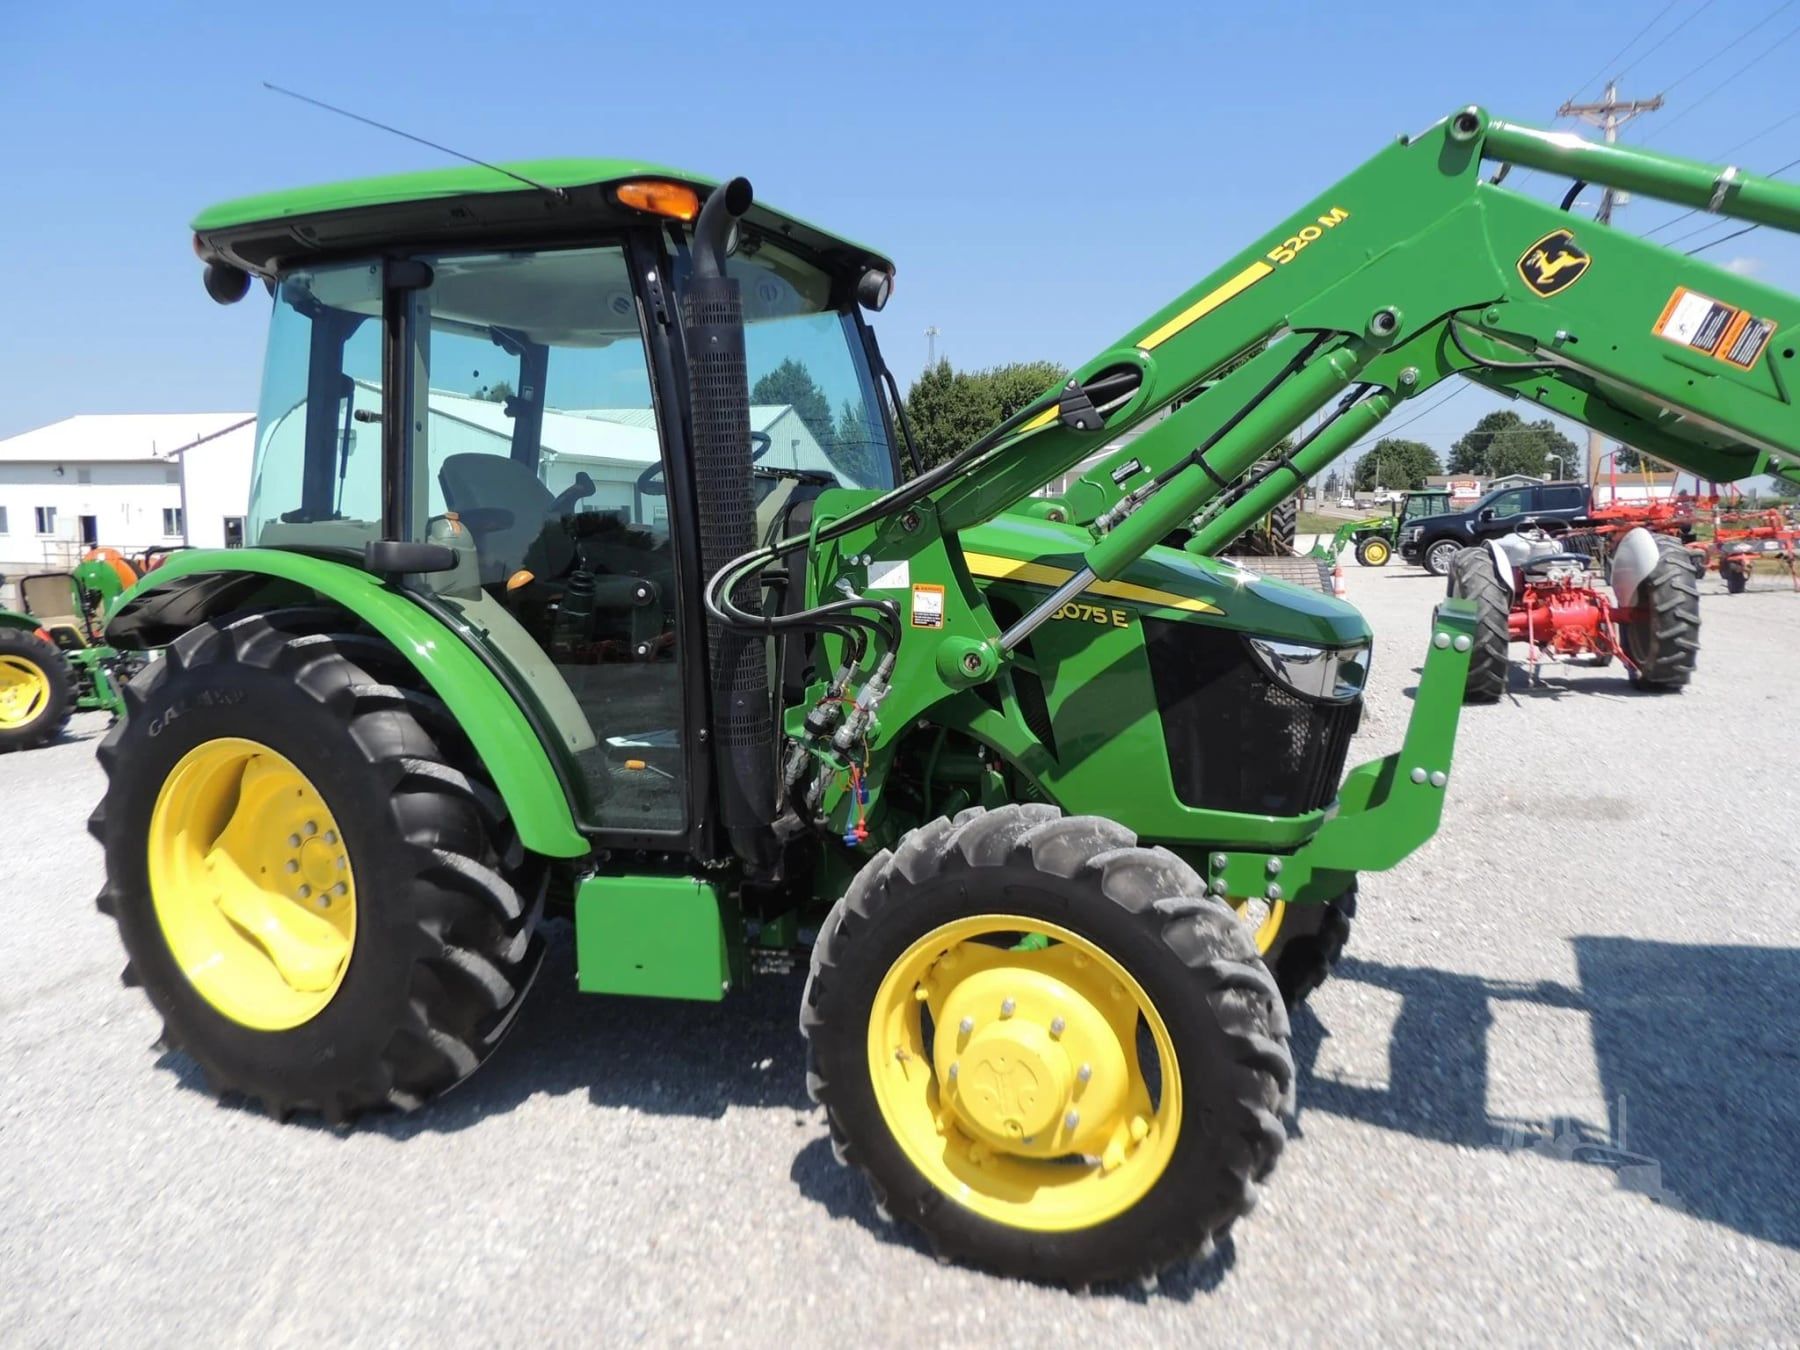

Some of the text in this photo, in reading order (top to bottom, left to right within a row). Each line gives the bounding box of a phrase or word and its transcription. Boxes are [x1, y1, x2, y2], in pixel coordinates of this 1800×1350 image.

[1266, 207, 1350, 264] 520 M
[1111, 609, 1129, 629] E
